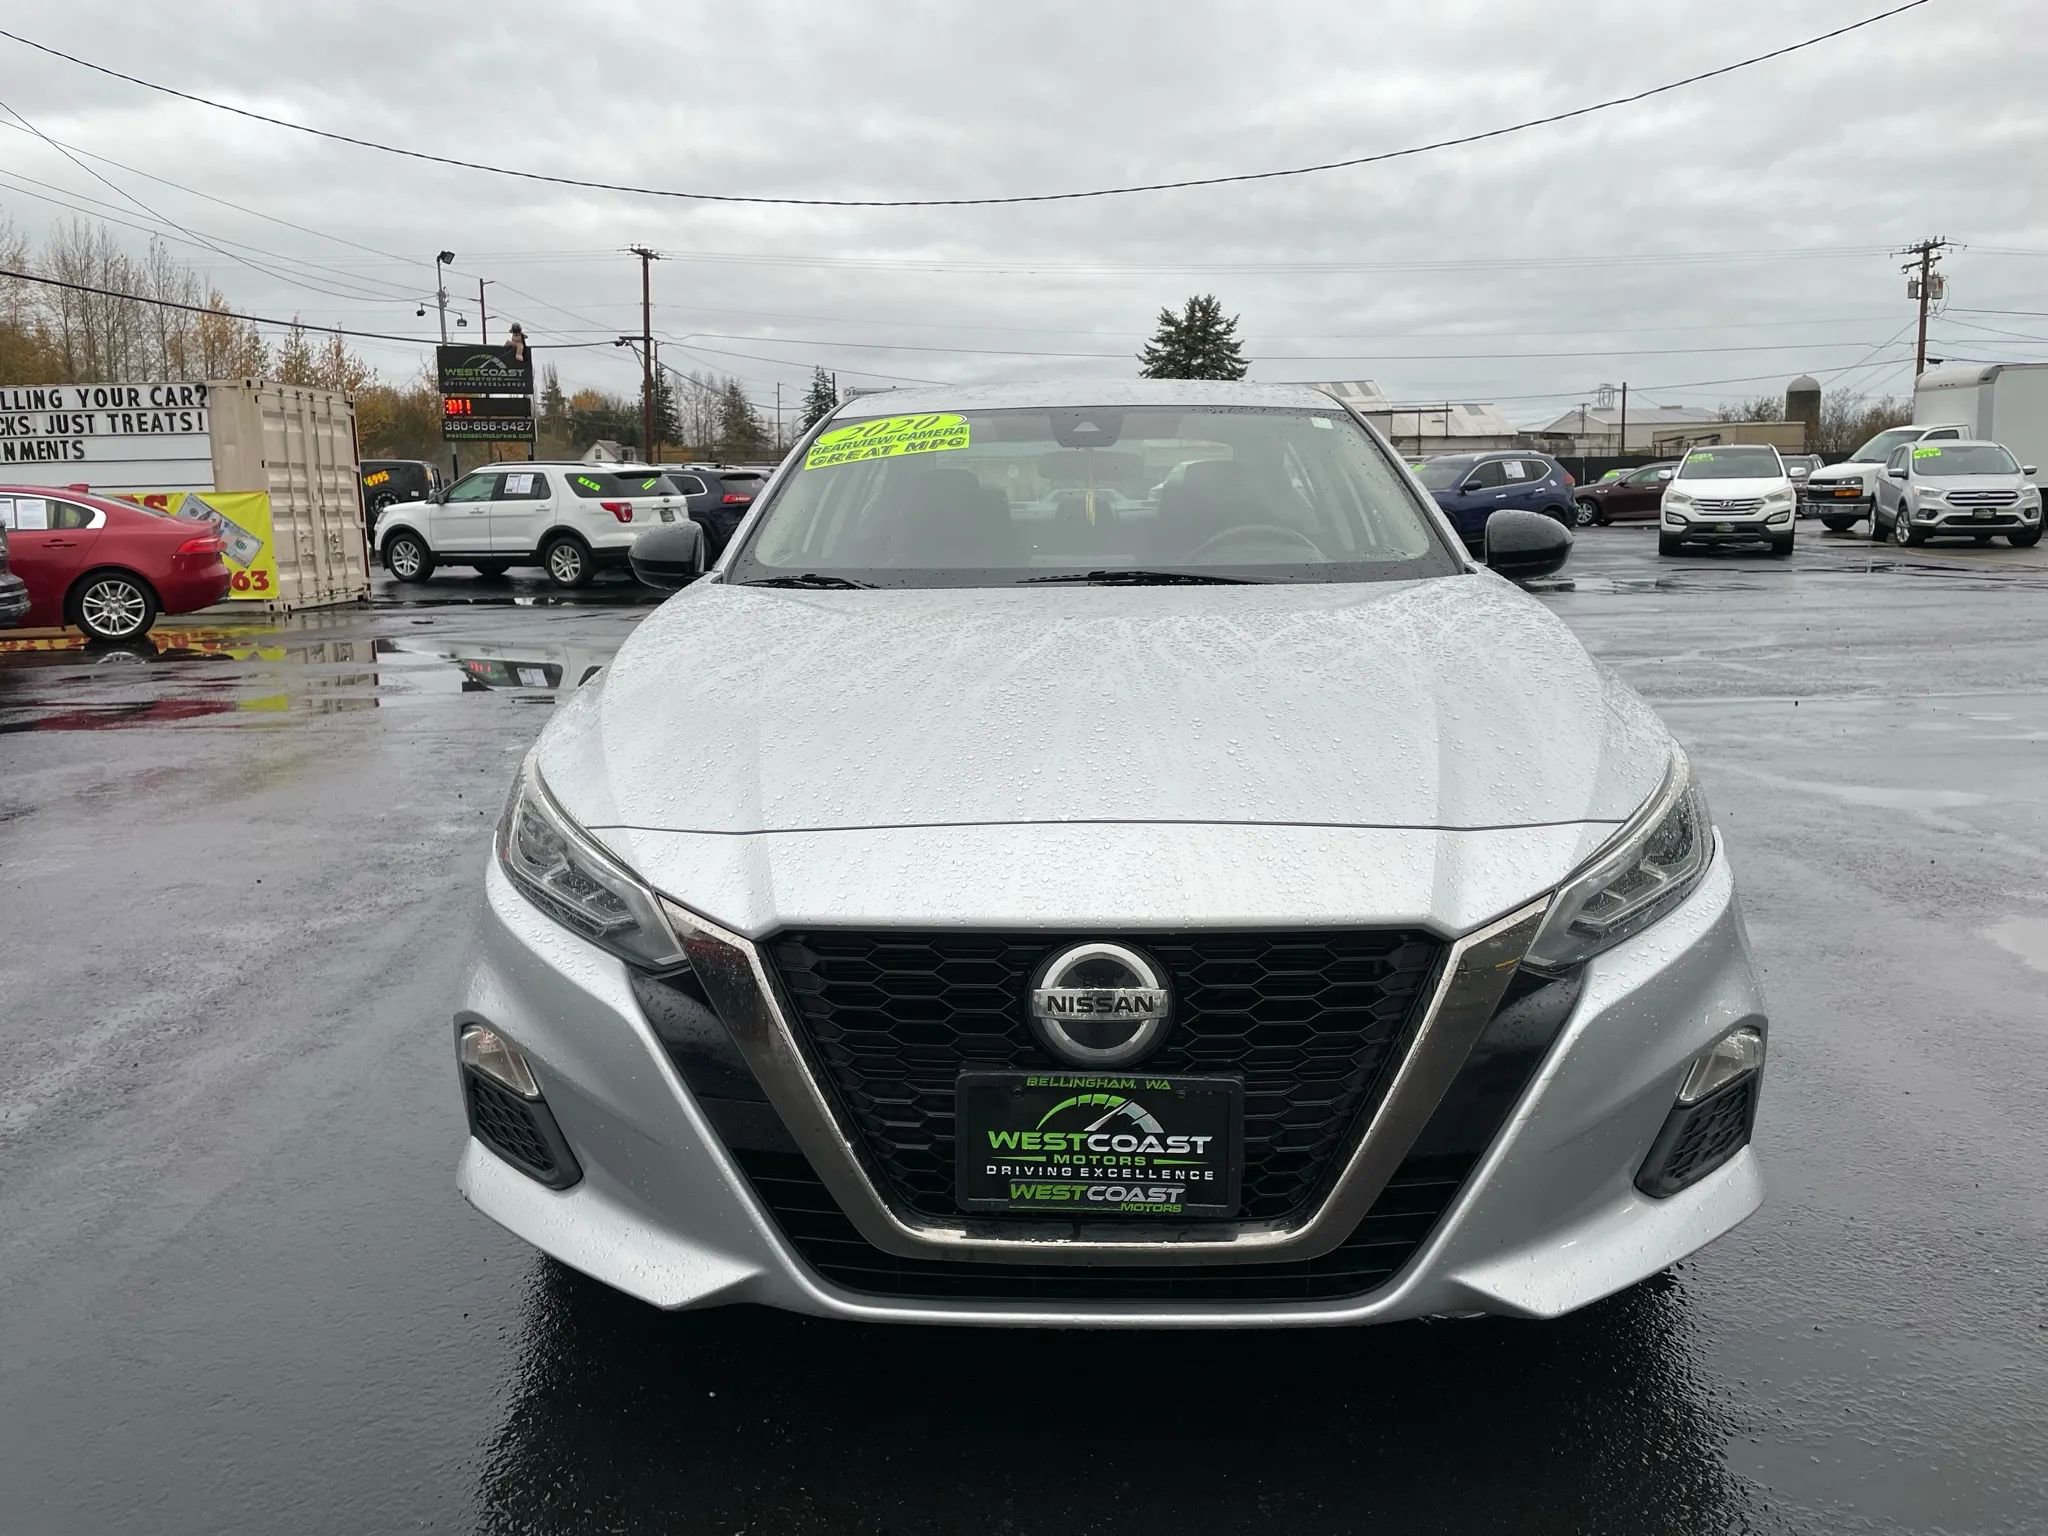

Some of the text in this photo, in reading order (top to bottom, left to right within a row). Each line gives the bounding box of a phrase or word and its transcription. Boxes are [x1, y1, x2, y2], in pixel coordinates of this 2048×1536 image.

[444, 368, 525, 376] WESTCOAST
[76, 386, 140, 409] YOUR
[151, 383, 209, 407] CAR?
[45, 414, 95, 434] JUST
[107, 410, 205, 433] TREATS!
[837, 416, 940, 442] 2020
[809, 426, 968, 457] REARVIEW CAMERA
[809, 437, 966, 466] GREAT MPG
[1046, 995, 1155, 1014] NISSAN
[1145, 1079, 1172, 1091] WA
[987, 1130, 1214, 1155] WESTCOAST
[1053, 1153, 1147, 1166] MOTORS
[986, 1165, 1215, 1181] DRIVING EXCELLENCE
[1009, 1183, 1186, 1204] WESTCOAST
[1120, 1202, 1183, 1214] MOTORS
